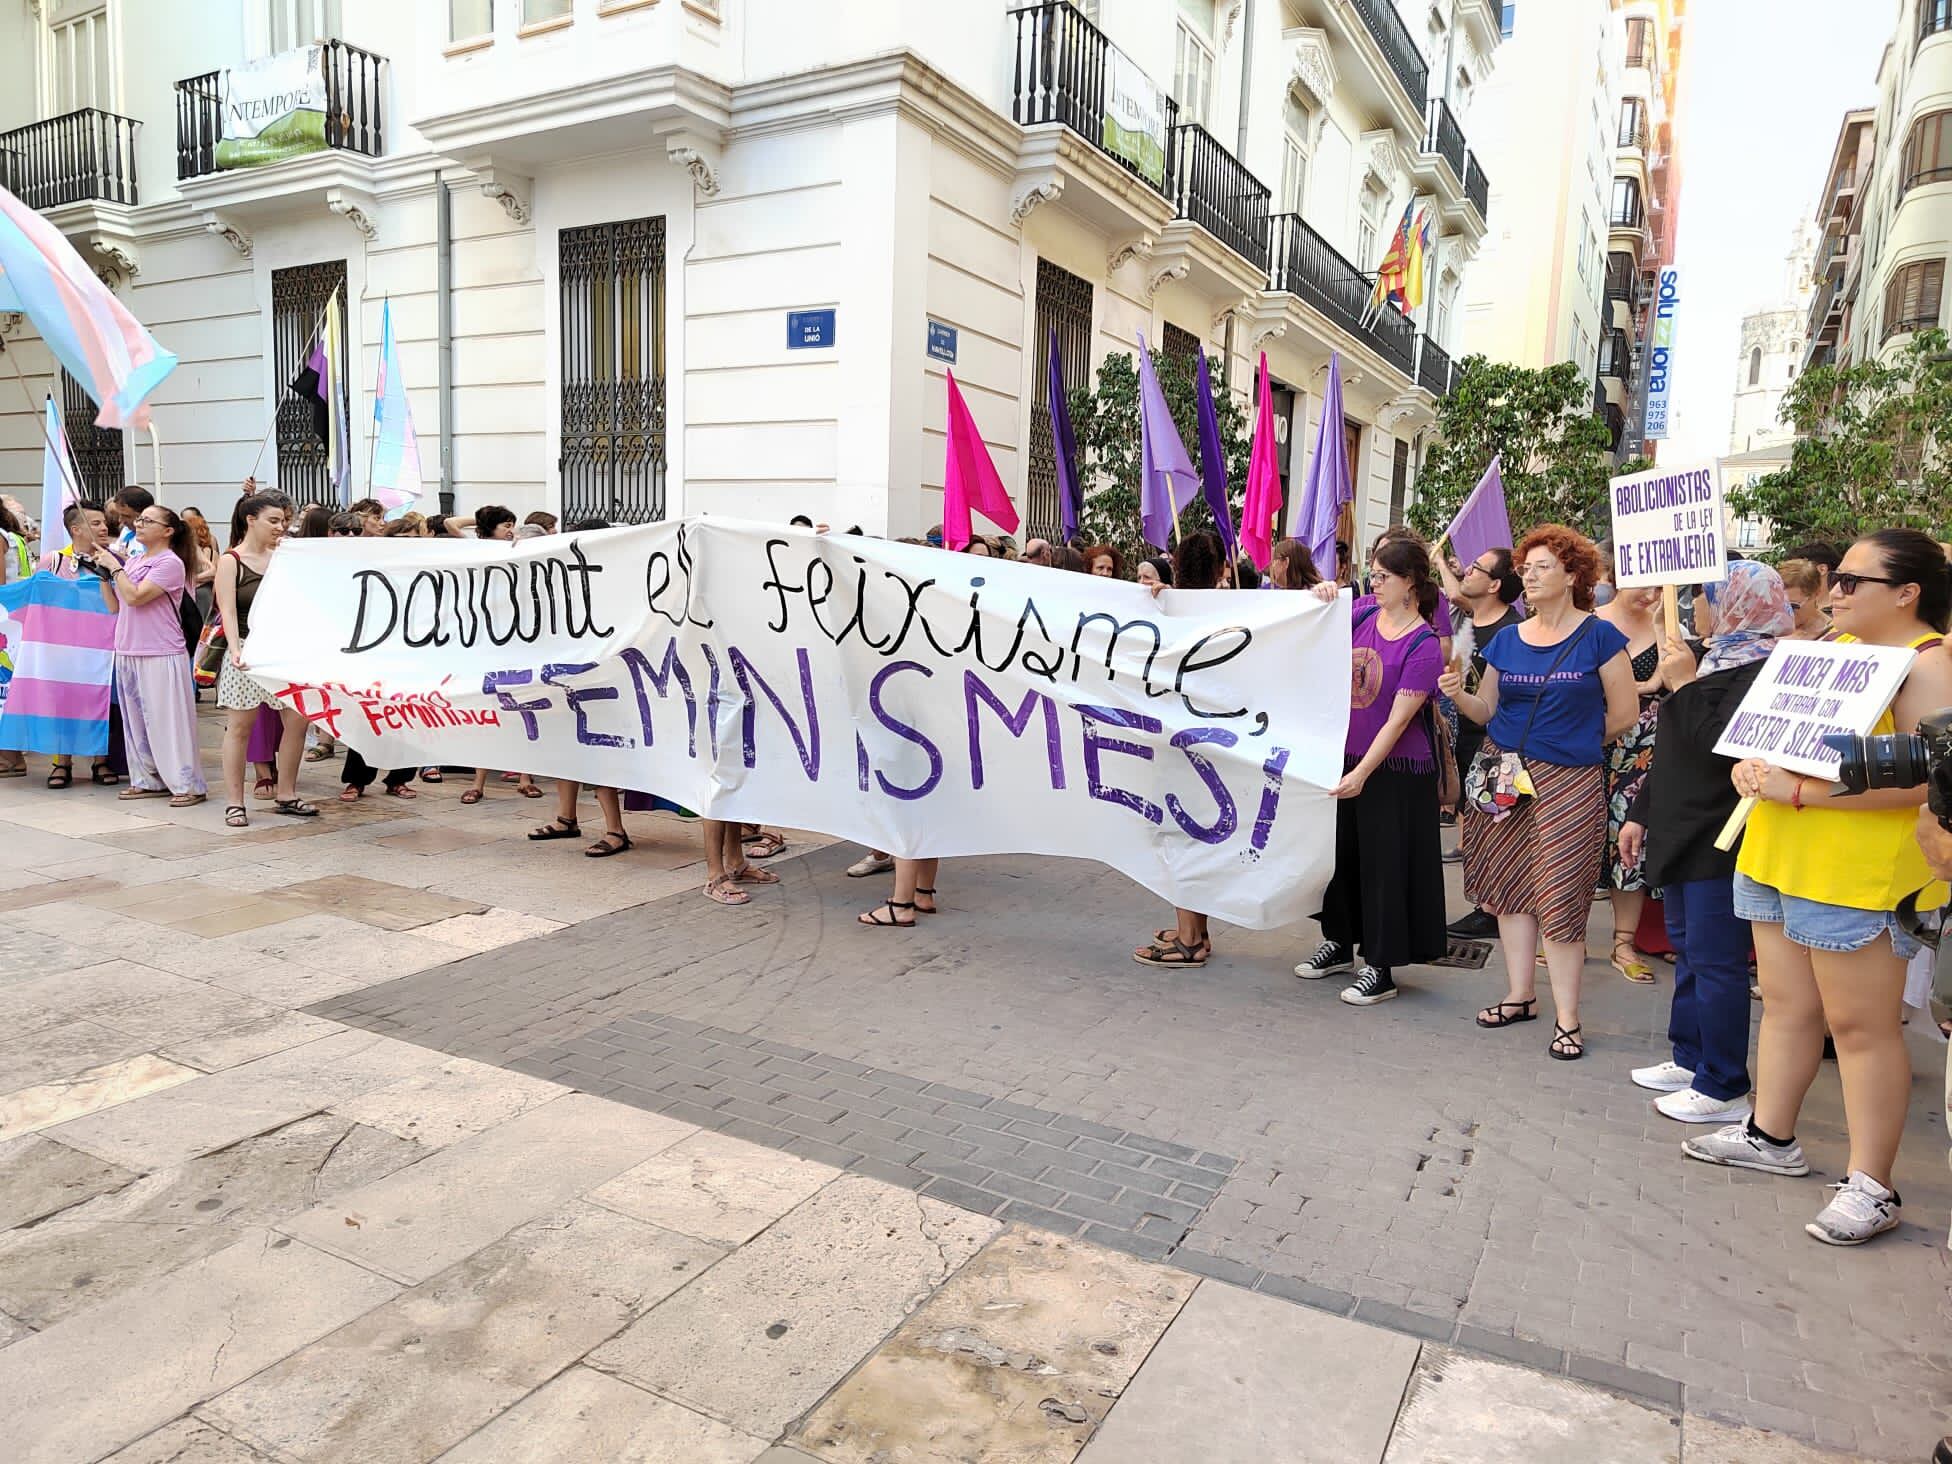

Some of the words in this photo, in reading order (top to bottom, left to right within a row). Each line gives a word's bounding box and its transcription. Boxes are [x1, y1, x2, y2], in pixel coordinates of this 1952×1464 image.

[1648, 411, 1666, 420] 975
[1649, 400, 1667, 409] 963
[1647, 421, 1665, 430] 206
[1616, 469, 1712, 517] ABOLICIONISTAS
[1674, 512, 1683, 532] DE
[1686, 511, 1696, 529] LA
[1699, 507, 1713, 528] LEY
[1619, 543, 1633, 576] DE
[1638, 527, 1716, 574] EXTRANJERÍA
[647, 523, 714, 629] el
[763, 539, 1268, 736] feixisme,
[1502, 671, 1583, 684] feminsme
[1773, 654, 1835, 689] NUNCA
[1828, 654, 1879, 694] MÁS
[1769, 690, 1822, 716] CONTARÁN
[1817, 698, 1844, 719] CON
[1724, 711, 1791, 752] NUESTRO
